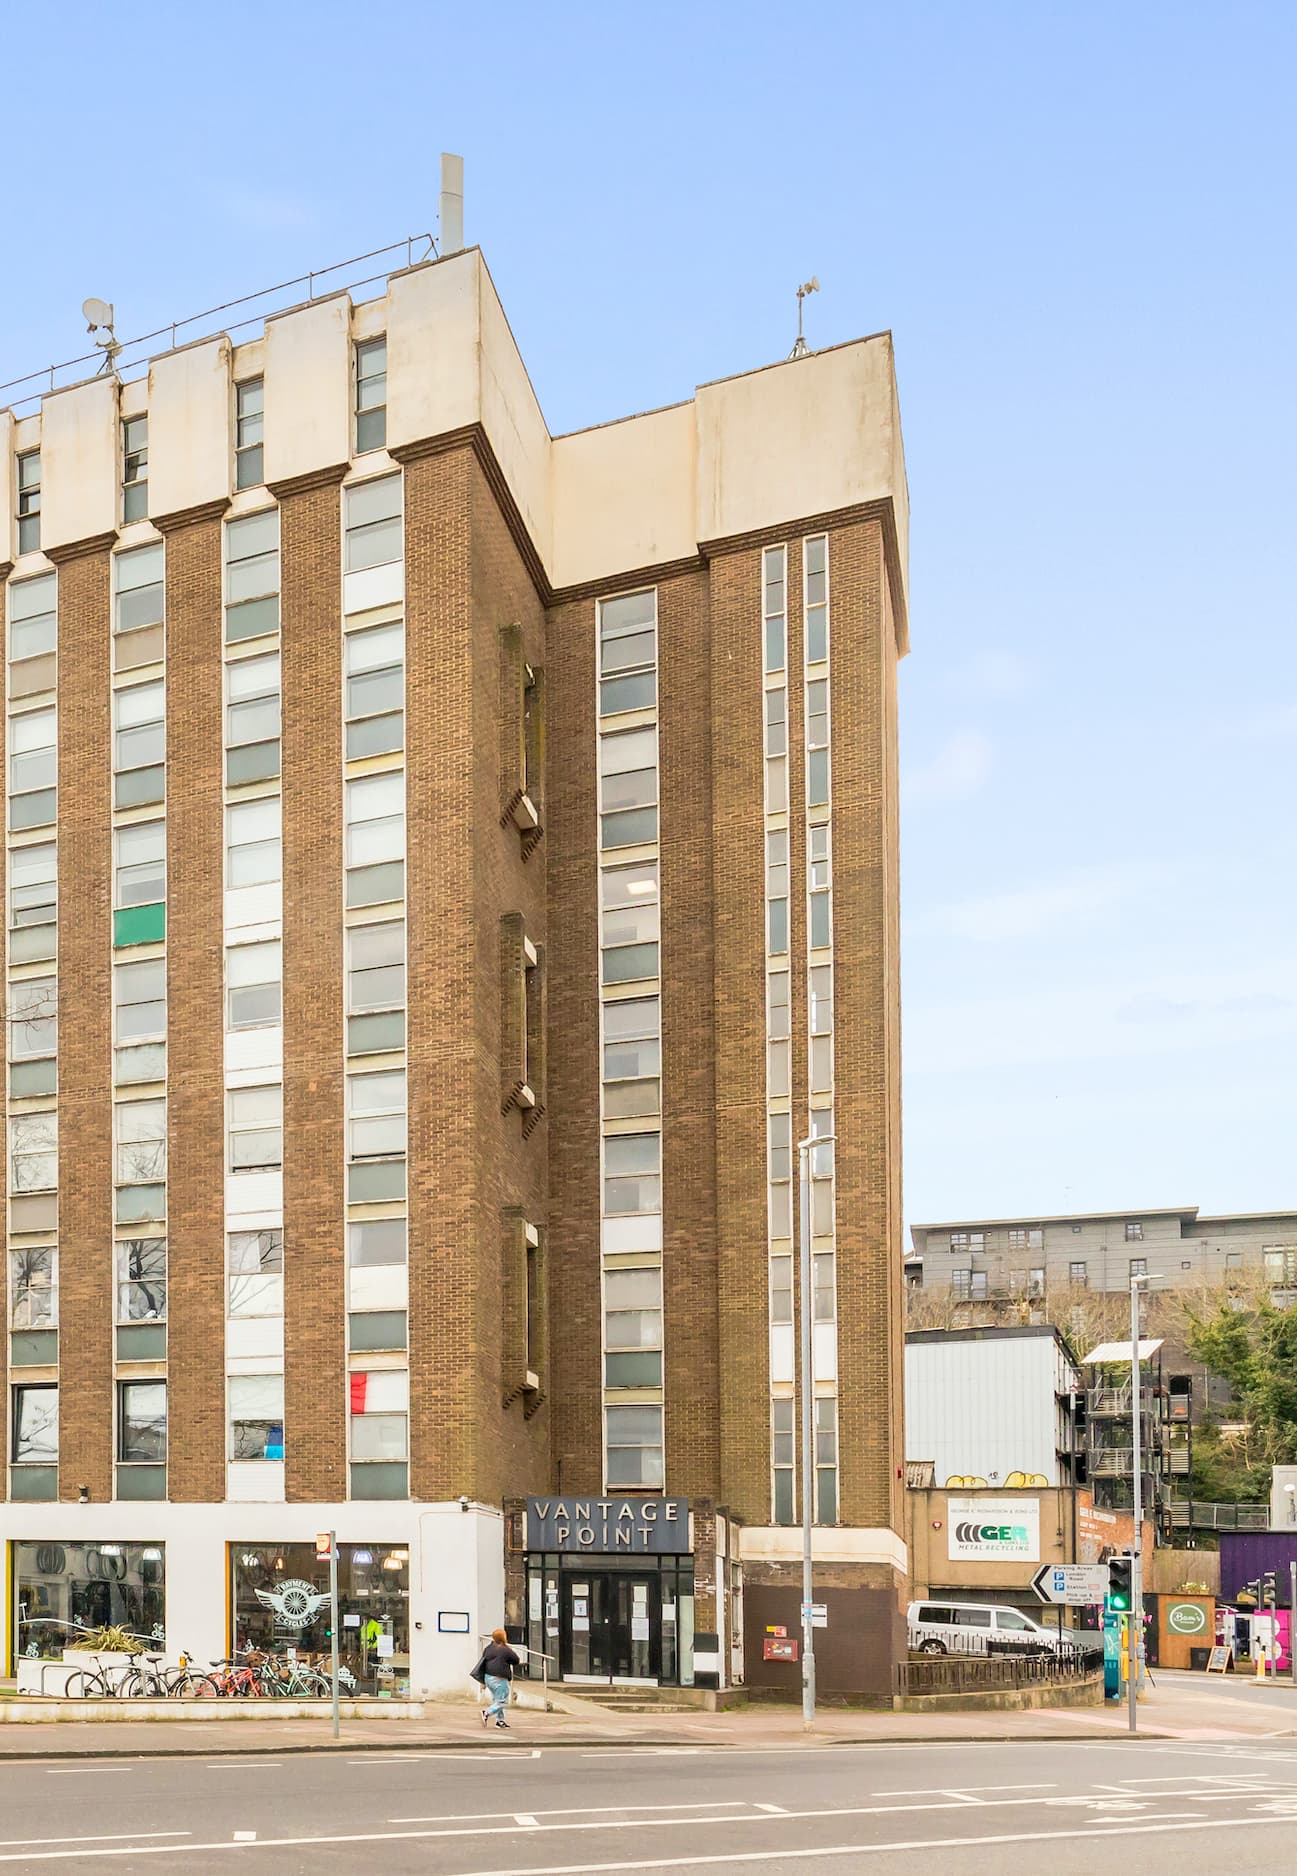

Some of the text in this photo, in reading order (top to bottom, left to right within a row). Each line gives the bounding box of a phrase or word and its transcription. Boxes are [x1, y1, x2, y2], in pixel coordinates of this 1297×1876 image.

[534, 1502, 679, 1521] VANTAGE
[558, 1527, 653, 1545] POINT
[980, 1525, 1029, 1541] GER
